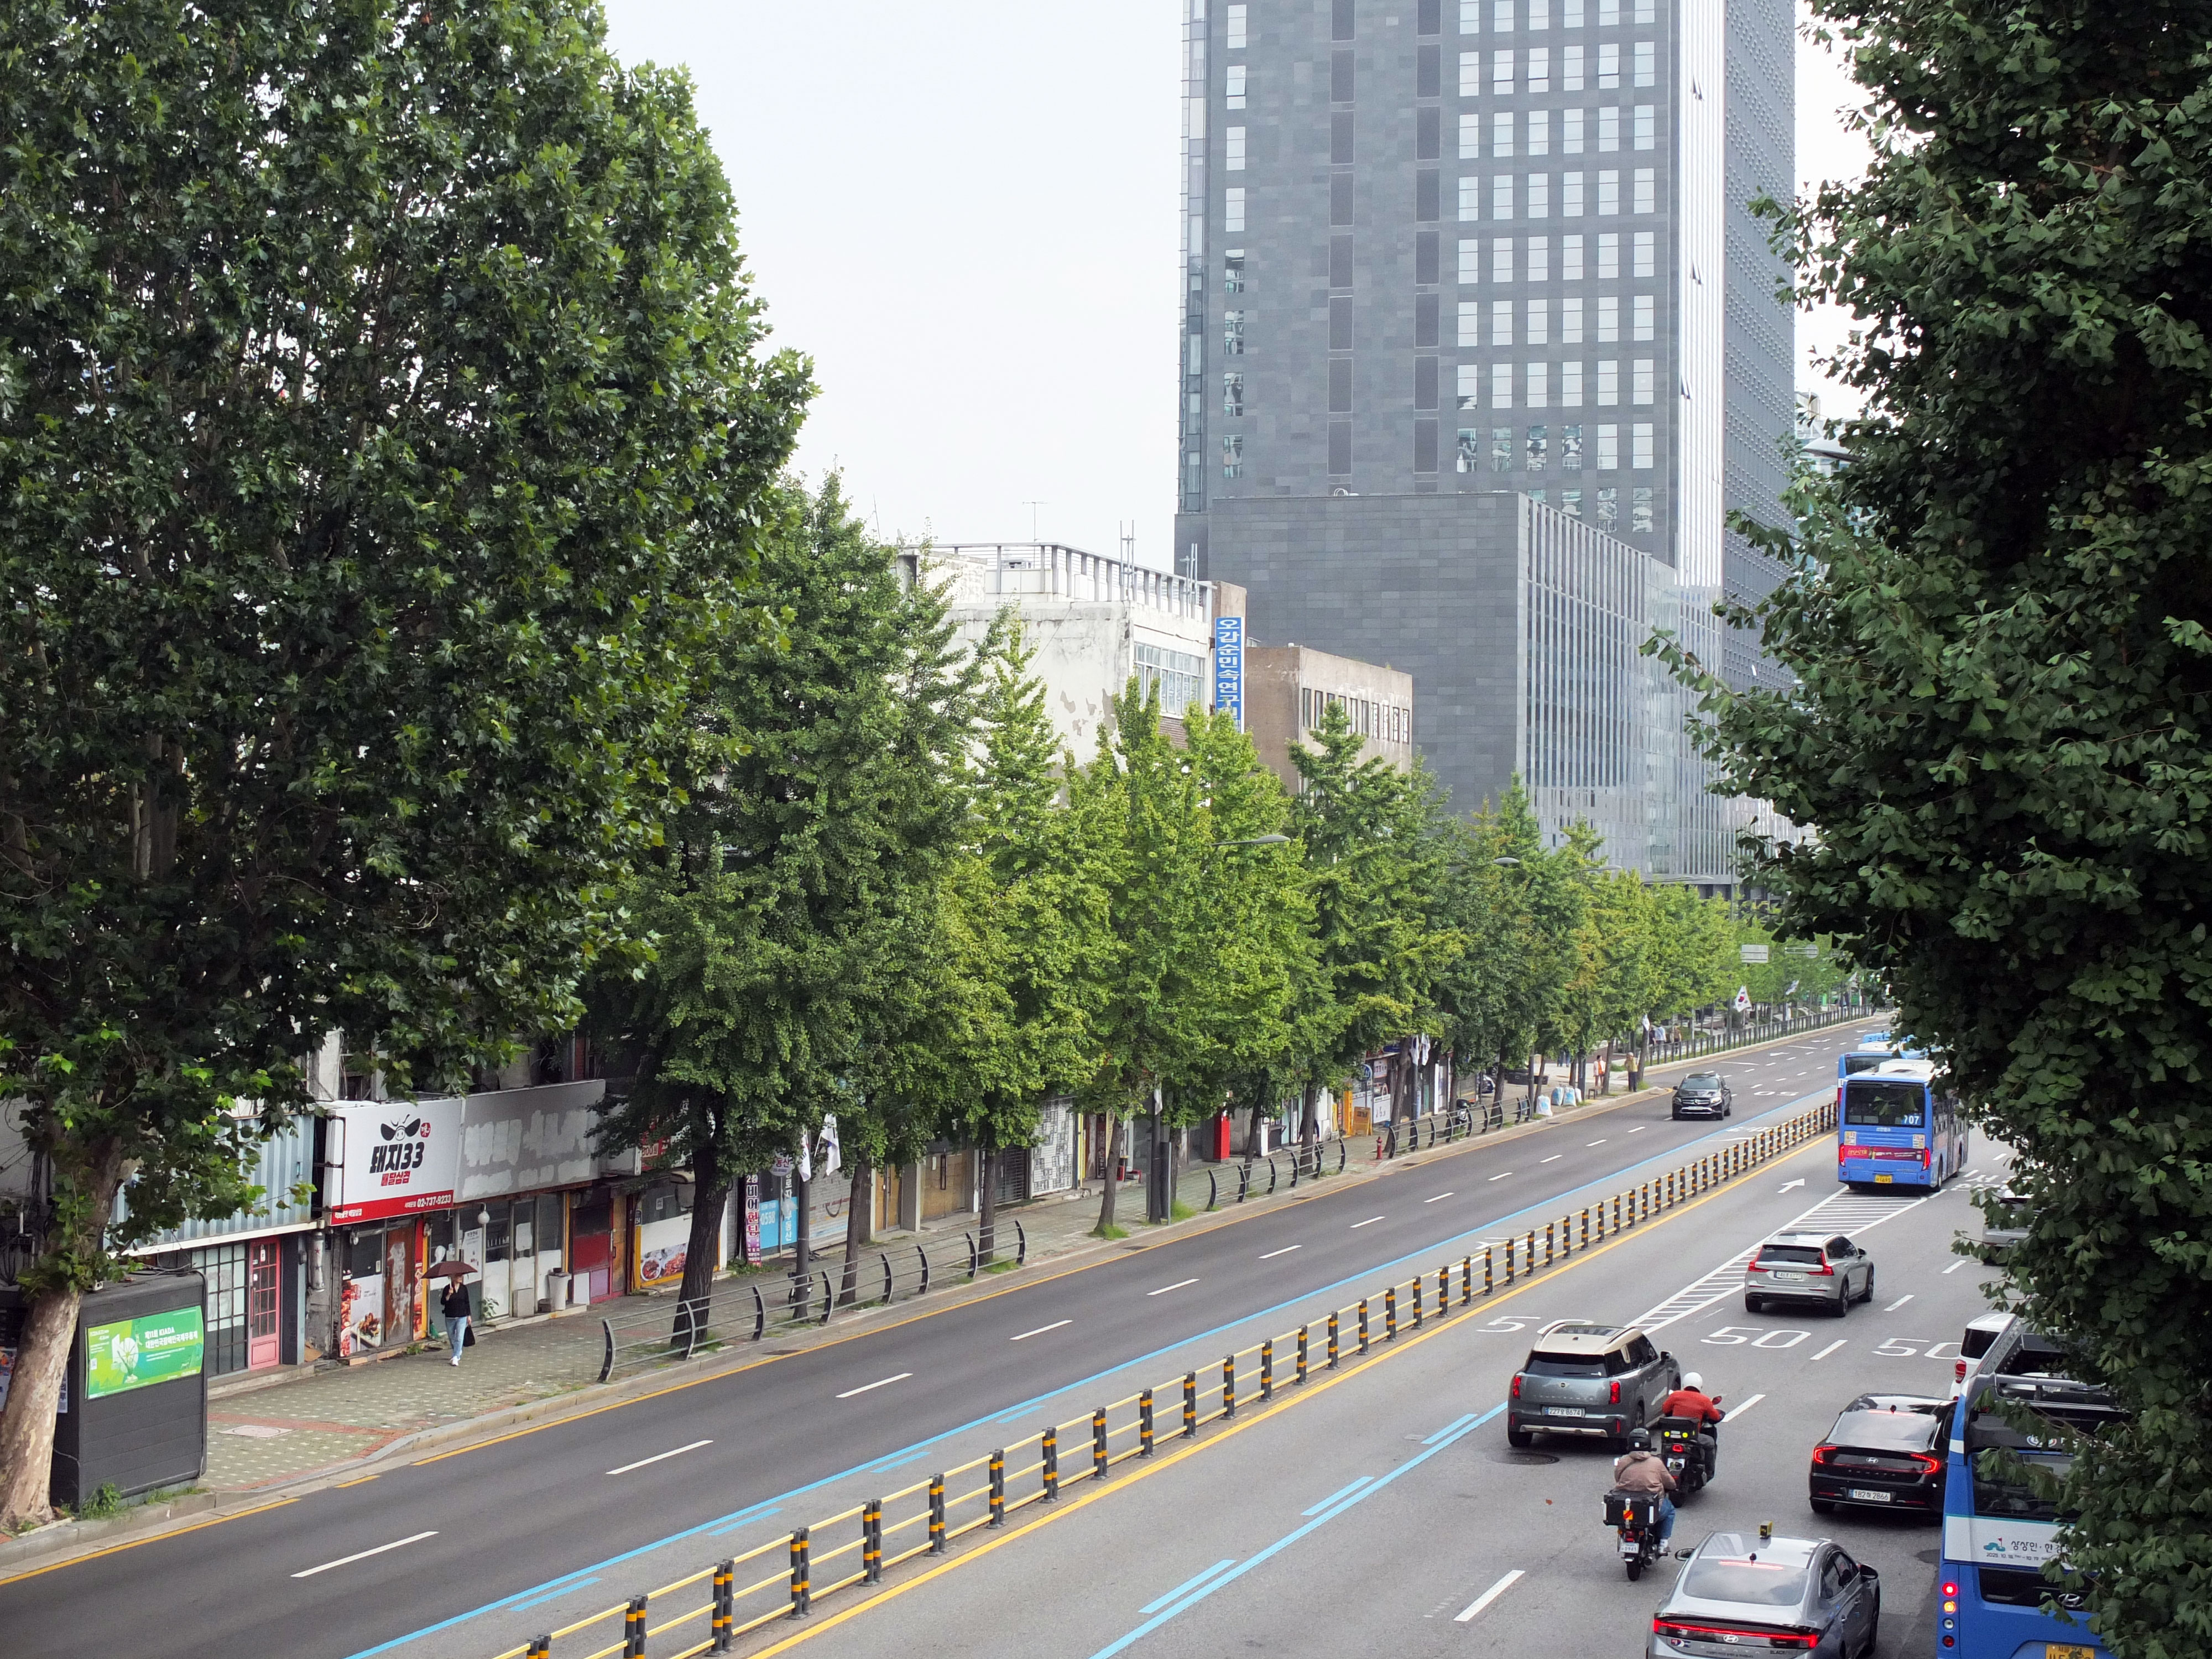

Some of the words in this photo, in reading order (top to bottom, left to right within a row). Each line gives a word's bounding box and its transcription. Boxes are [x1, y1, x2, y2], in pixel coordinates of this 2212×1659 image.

[1904, 1115, 1919, 1124] 707
[369, 1142, 425, 1173] 돼지33
[1700, 1326, 1811, 1348] 50
